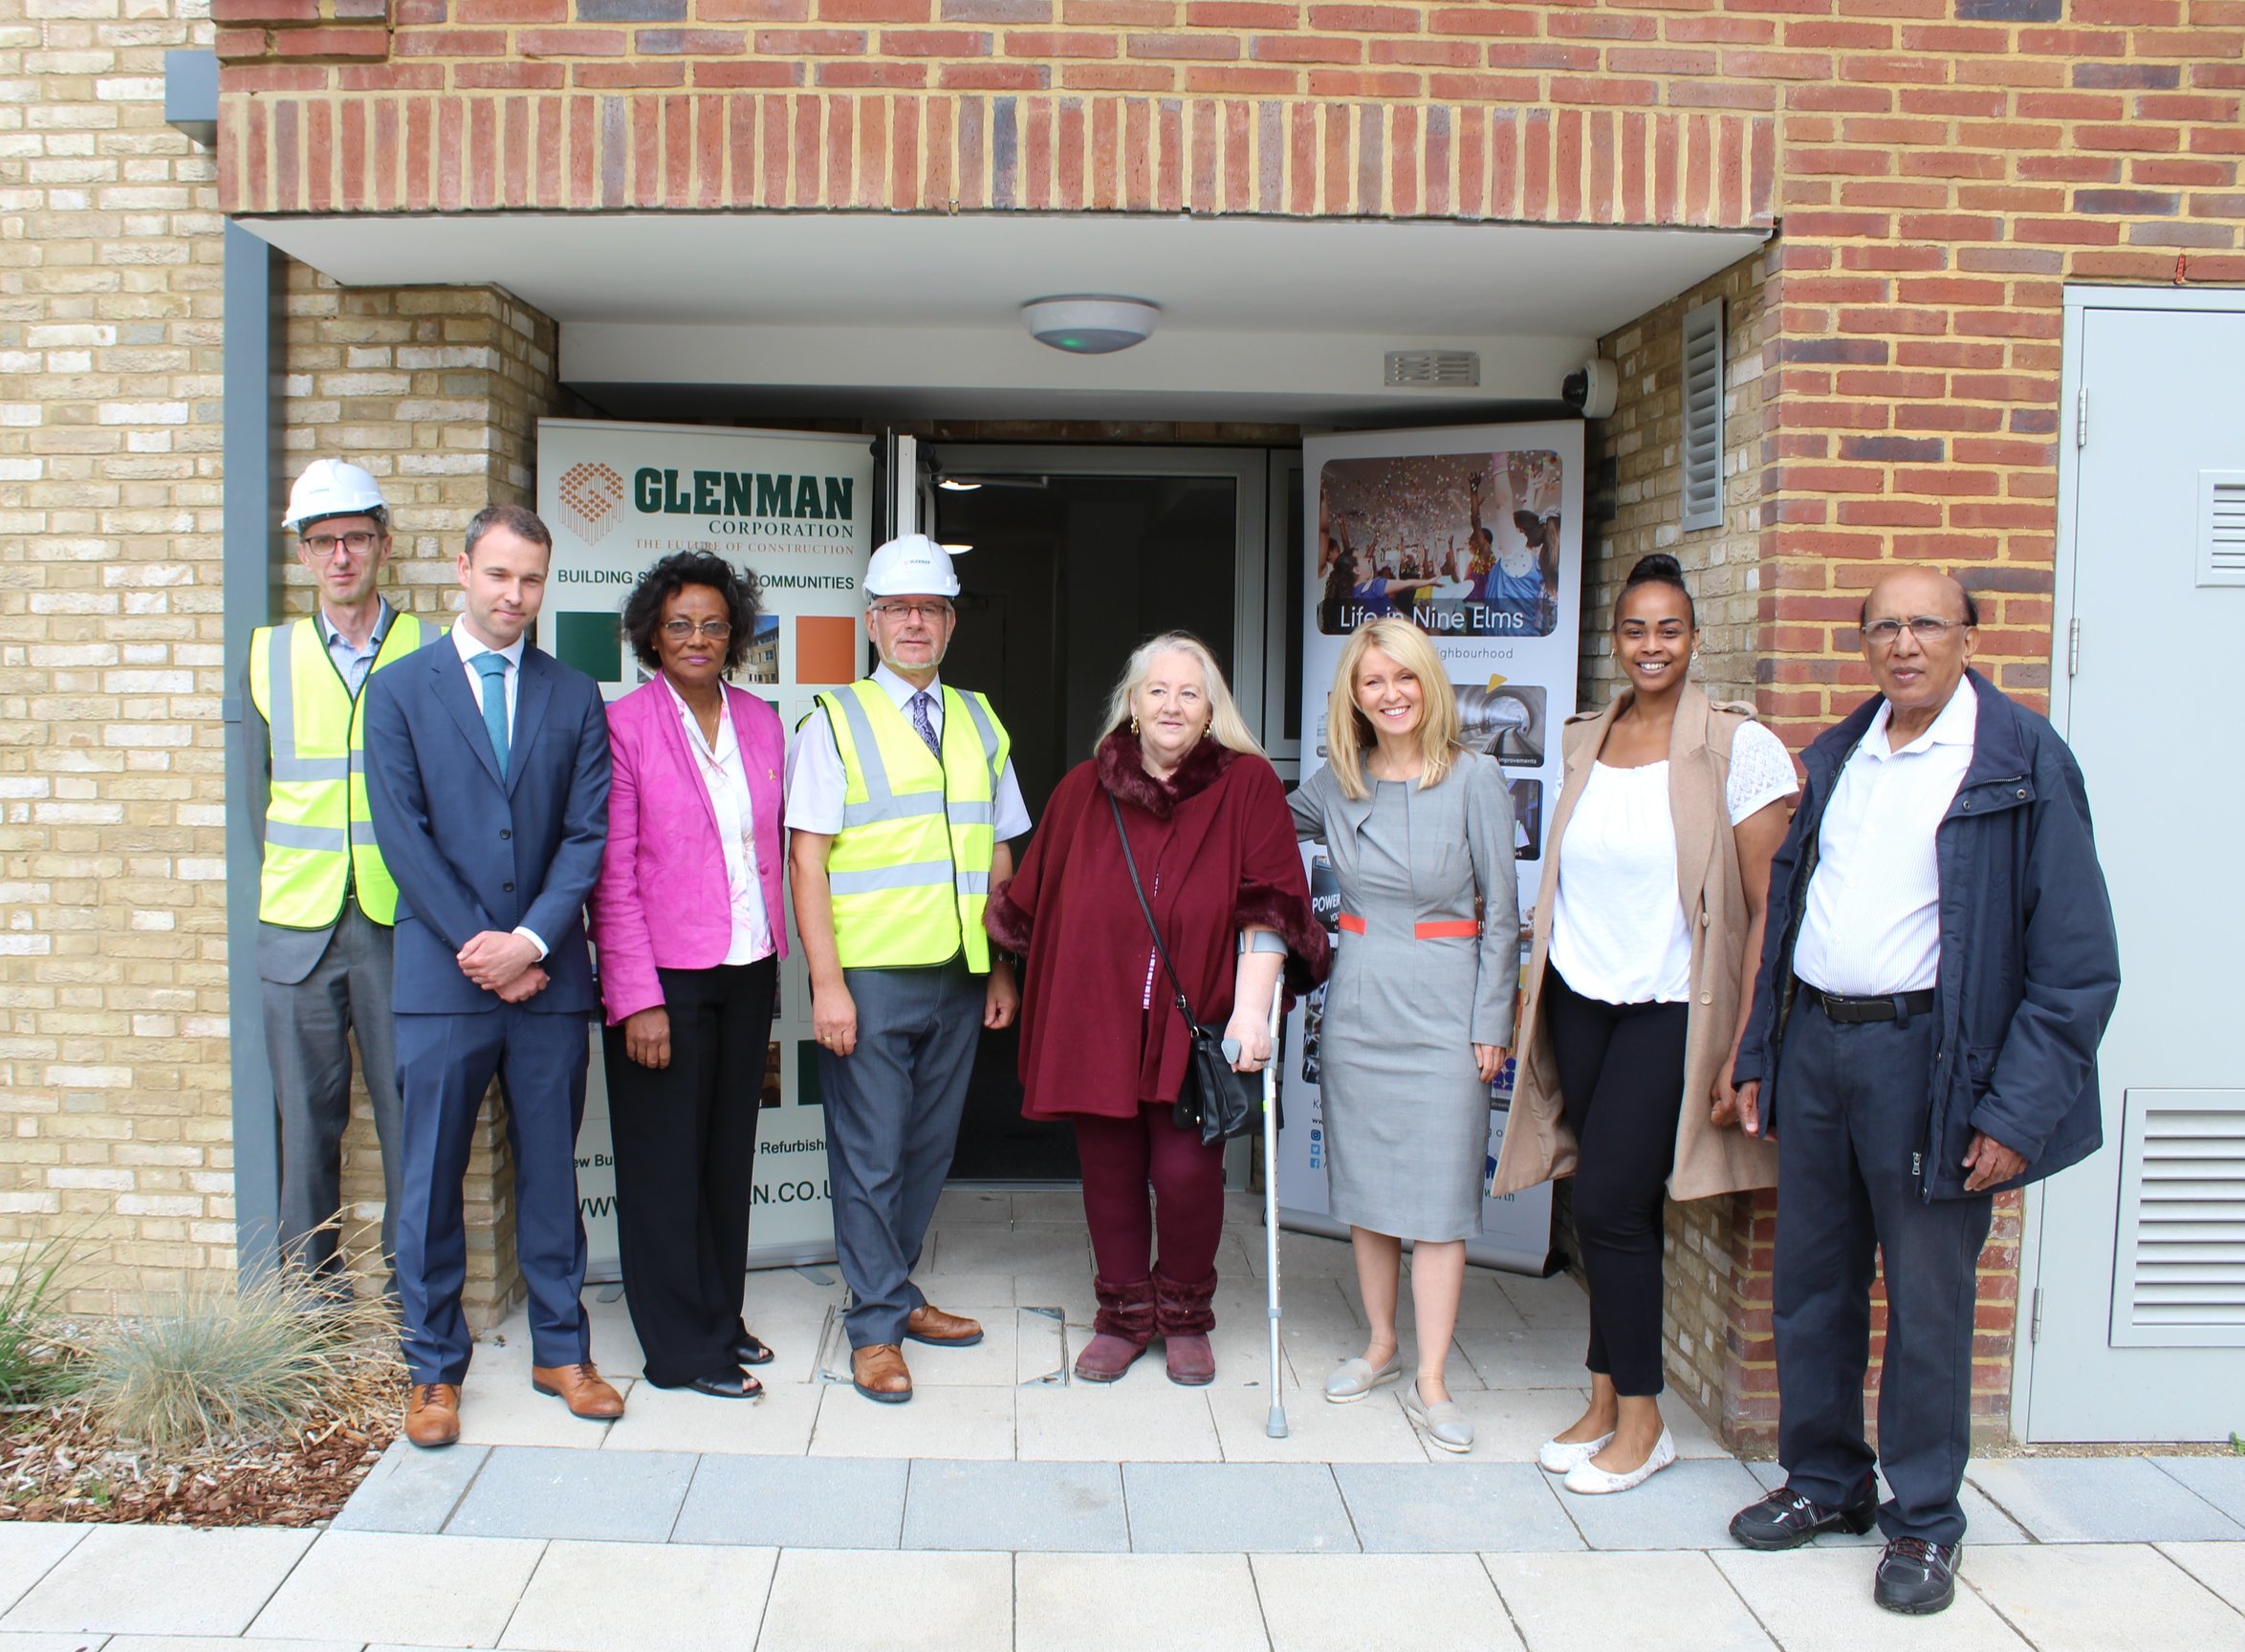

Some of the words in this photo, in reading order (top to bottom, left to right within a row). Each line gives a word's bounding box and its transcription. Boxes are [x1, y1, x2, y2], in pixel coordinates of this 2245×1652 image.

[635, 467, 854, 521] GLENMAN
[708, 519, 854, 538] CORPORATION
[635, 538, 663, 550] THE
[667, 540, 721, 552] FUTURE
[726, 542, 743, 552] OF
[749, 542, 854, 555] CONSTRUCTION
[558, 569, 633, 584] BUILDING
[755, 575, 855, 590] OMMUNITIES
[1340, 605, 1378, 628] Life
[1413, 605, 1465, 629] Nine
[1472, 606, 1524, 628] Elms
[573, 1157, 590, 1169] ew
[595, 1154, 613, 1167] Bu
[761, 1139, 827, 1155] Refurbish
